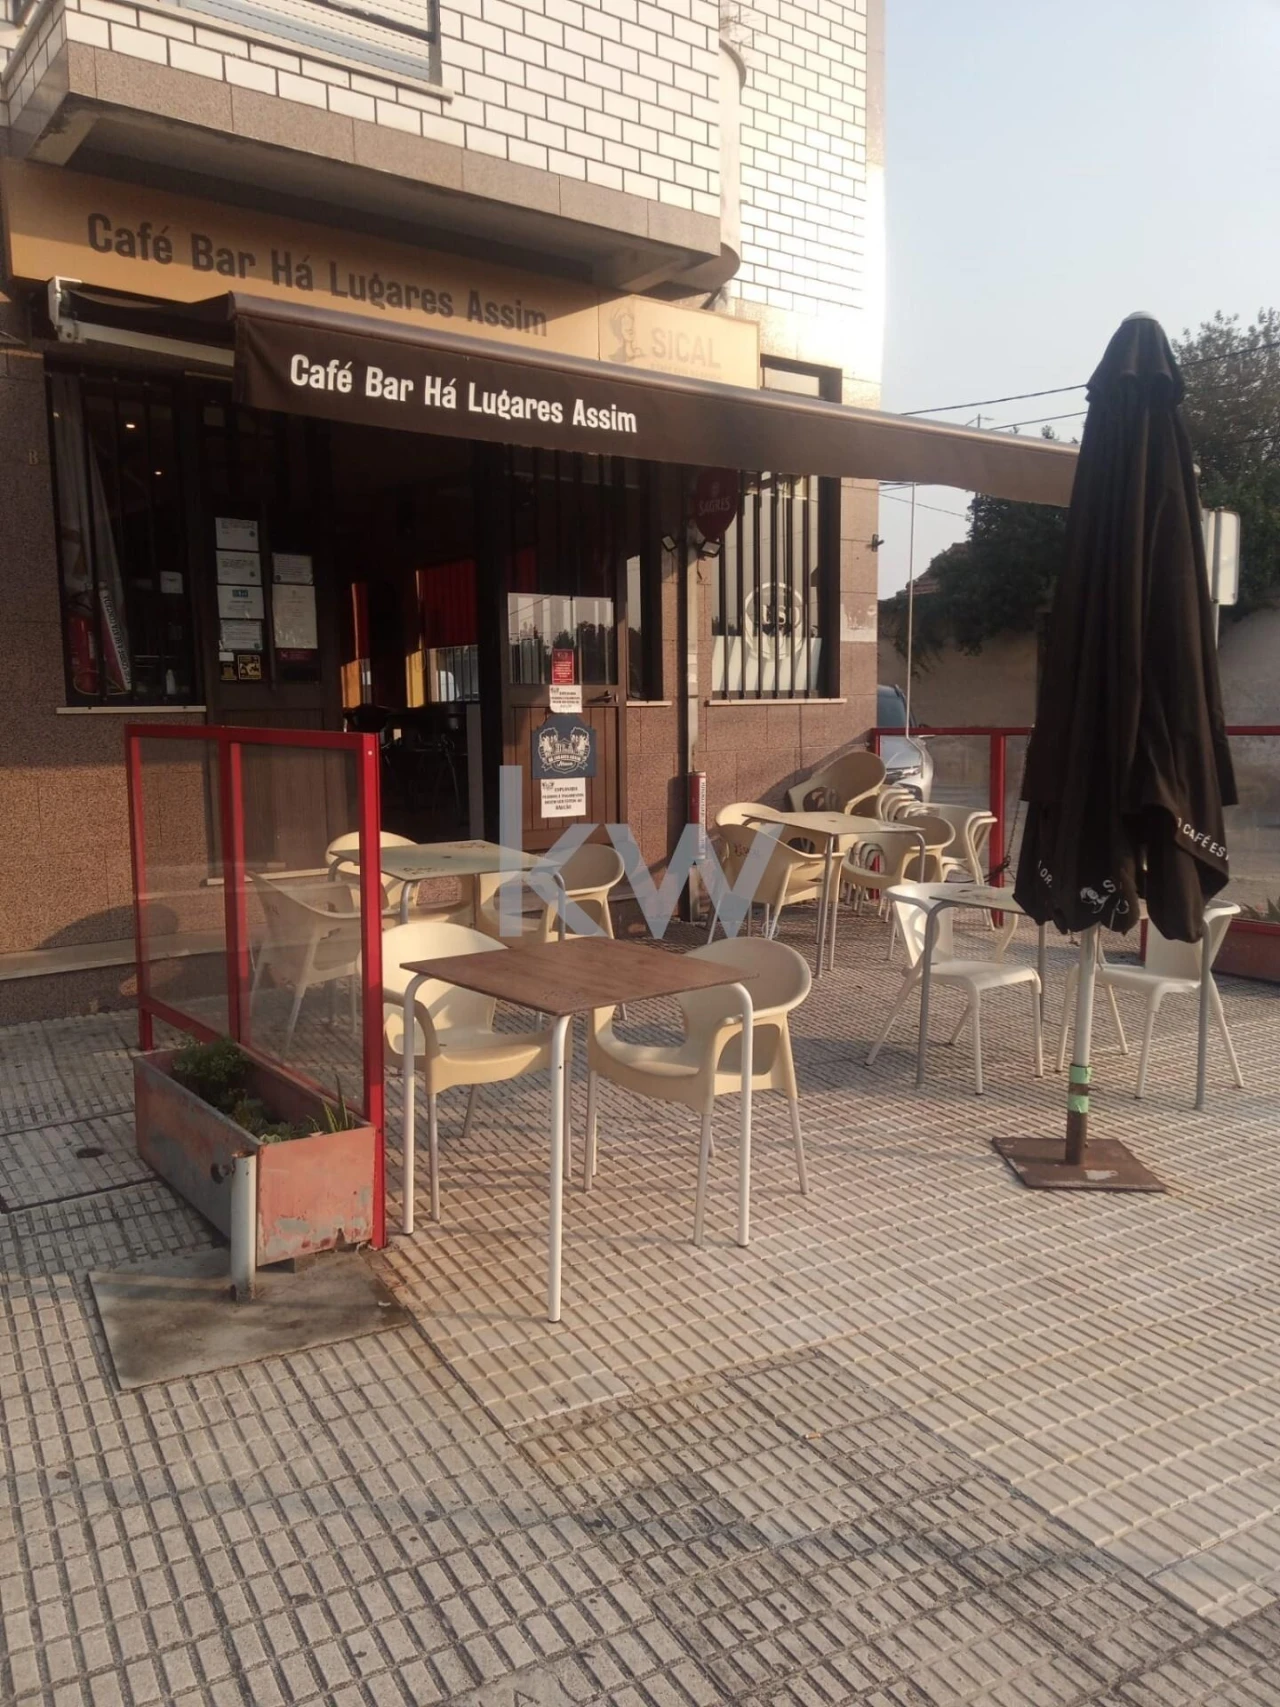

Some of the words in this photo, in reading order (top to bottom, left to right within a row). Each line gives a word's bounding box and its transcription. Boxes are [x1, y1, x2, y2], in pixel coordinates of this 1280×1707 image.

[88, 213, 173, 265] Café
[191, 233, 256, 280] Bar
[271, 249, 314, 293] Há
[329, 261, 454, 319] Lugares
[466, 290, 548, 337] Assim
[651, 327, 721, 369] SICAL
[290, 354, 353, 393] Café
[365, 366, 414, 402] Bar
[424, 376, 457, 409] Há
[468, 381, 564, 423] Lugares
[572, 398, 638, 433] Assim
[1182, 823, 1211, 848] CAFÉ
